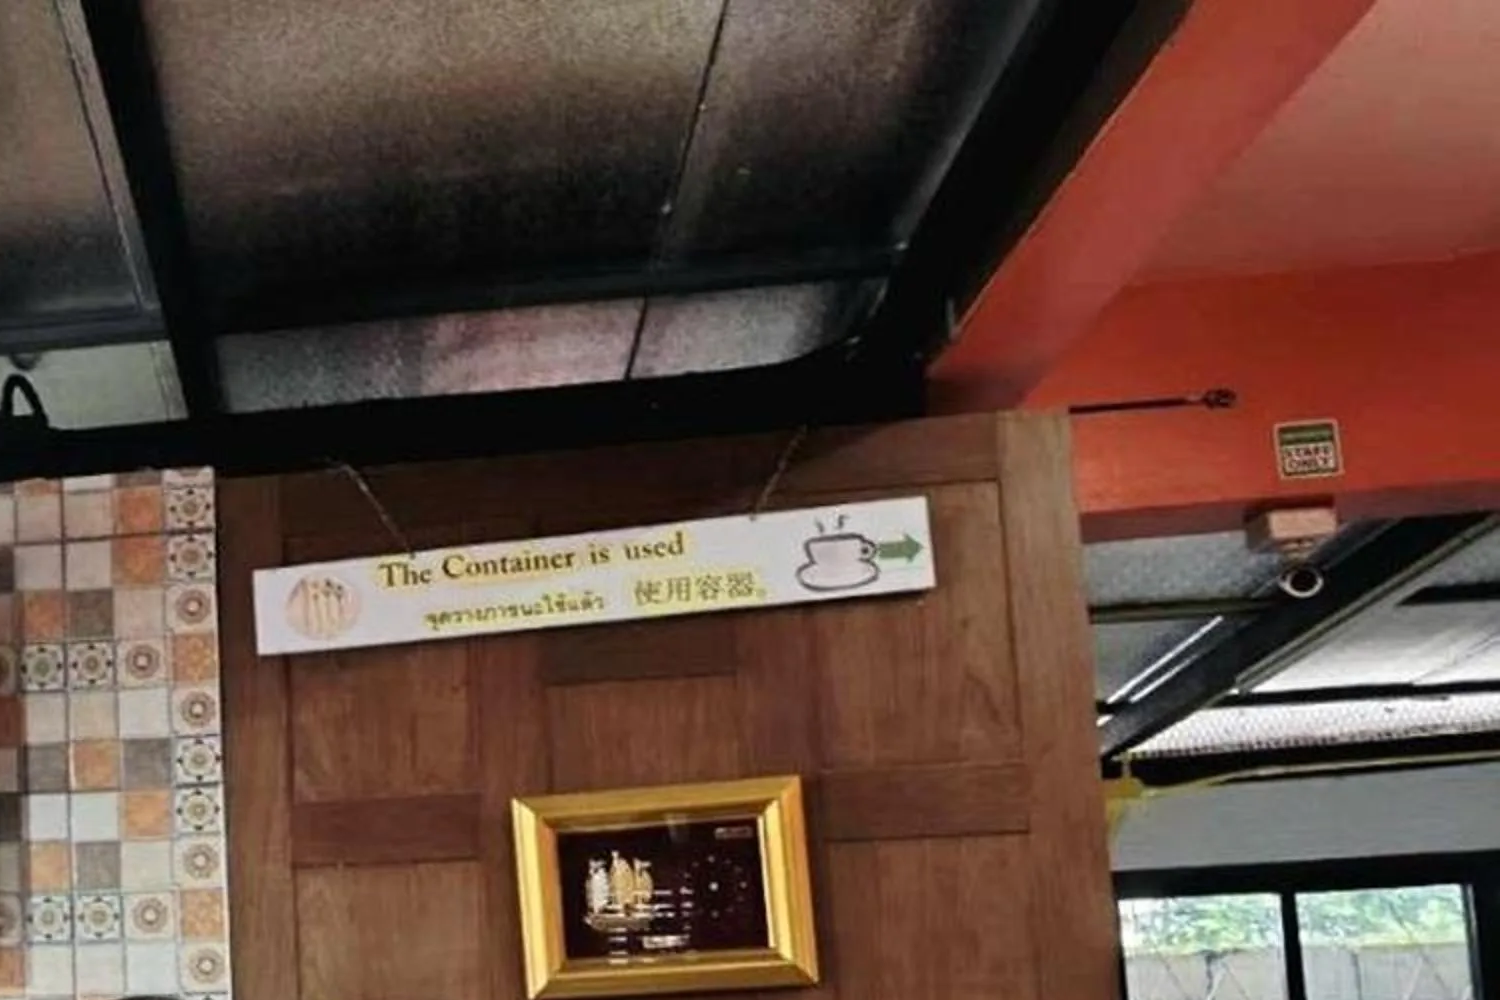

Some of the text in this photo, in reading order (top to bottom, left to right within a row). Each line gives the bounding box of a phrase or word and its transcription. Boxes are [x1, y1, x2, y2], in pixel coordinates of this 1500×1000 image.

[378, 531, 685, 588] The Container is used
